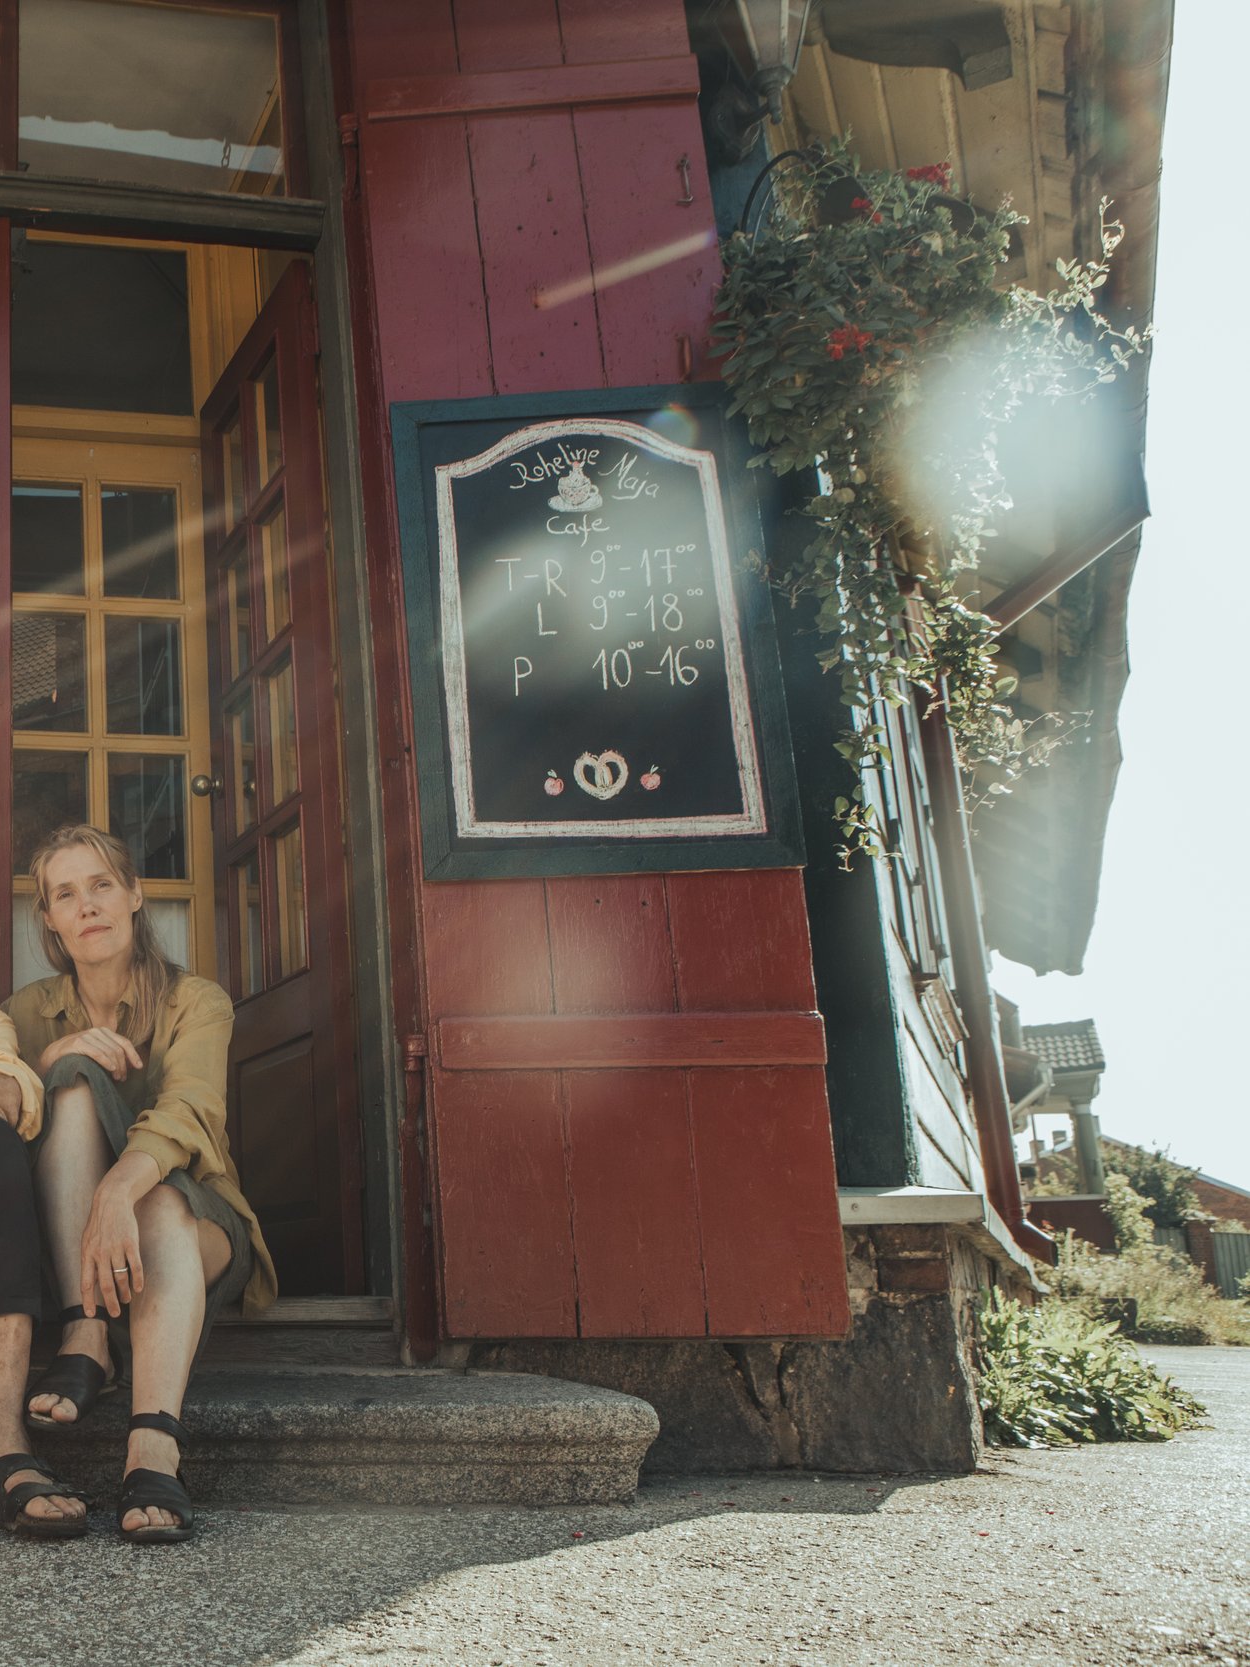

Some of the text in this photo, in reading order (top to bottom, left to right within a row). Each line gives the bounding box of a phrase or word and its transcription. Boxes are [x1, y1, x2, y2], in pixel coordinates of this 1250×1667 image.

[509, 442, 660, 500] Roheline Maja
[546, 514, 610, 548] Cafe
[495, 557, 567, 598] T-R
[537, 602, 558, 636] L
[514, 656, 533, 697] P
